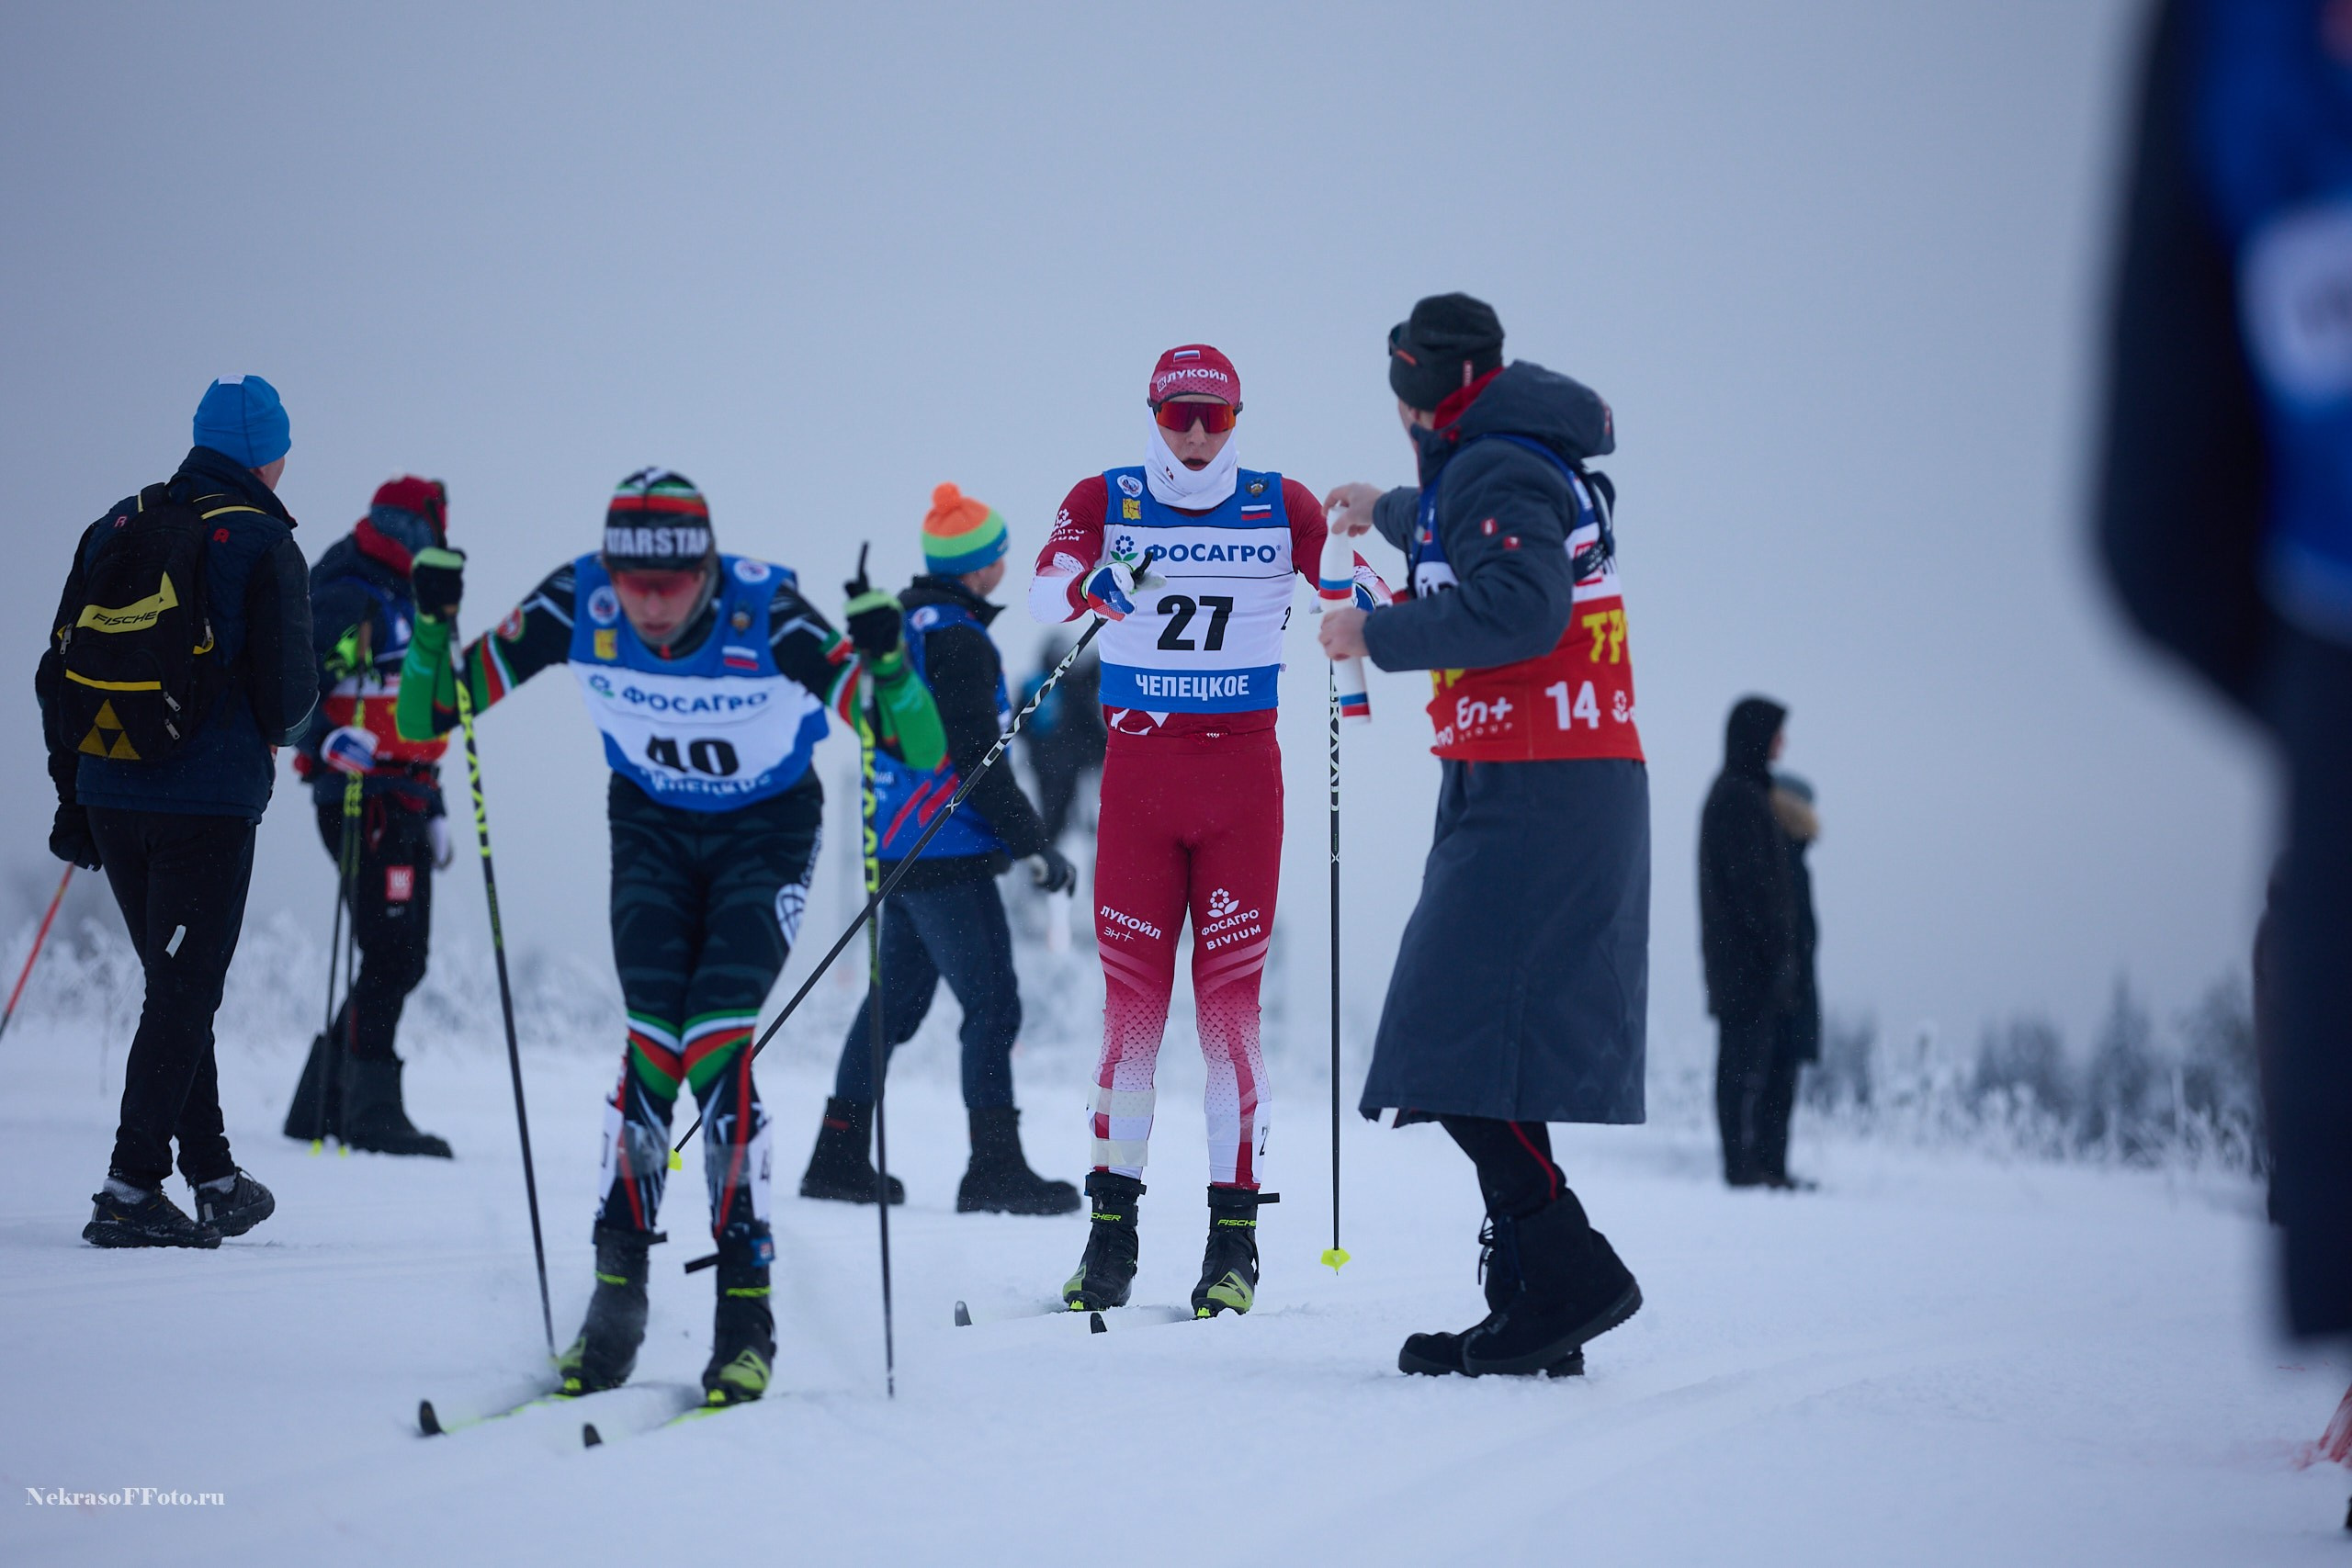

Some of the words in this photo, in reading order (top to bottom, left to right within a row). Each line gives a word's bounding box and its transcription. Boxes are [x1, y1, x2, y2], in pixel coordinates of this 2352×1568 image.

[1167, 368, 1228, 384] ЛУКОЙЛ
[1157, 594, 1234, 650] 27
[622, 686, 768, 714] ФОСАГРО
[1135, 673, 1250, 702] ЧЕПЕЦКОЕ
[1545, 681, 1600, 731] 14
[646, 734, 740, 776] 40
[1101, 906, 1161, 940] ЛУКОЙЛ
[1202, 909, 1260, 936] ФОСАГРО
[1206, 925, 1261, 951] BIVIUM
